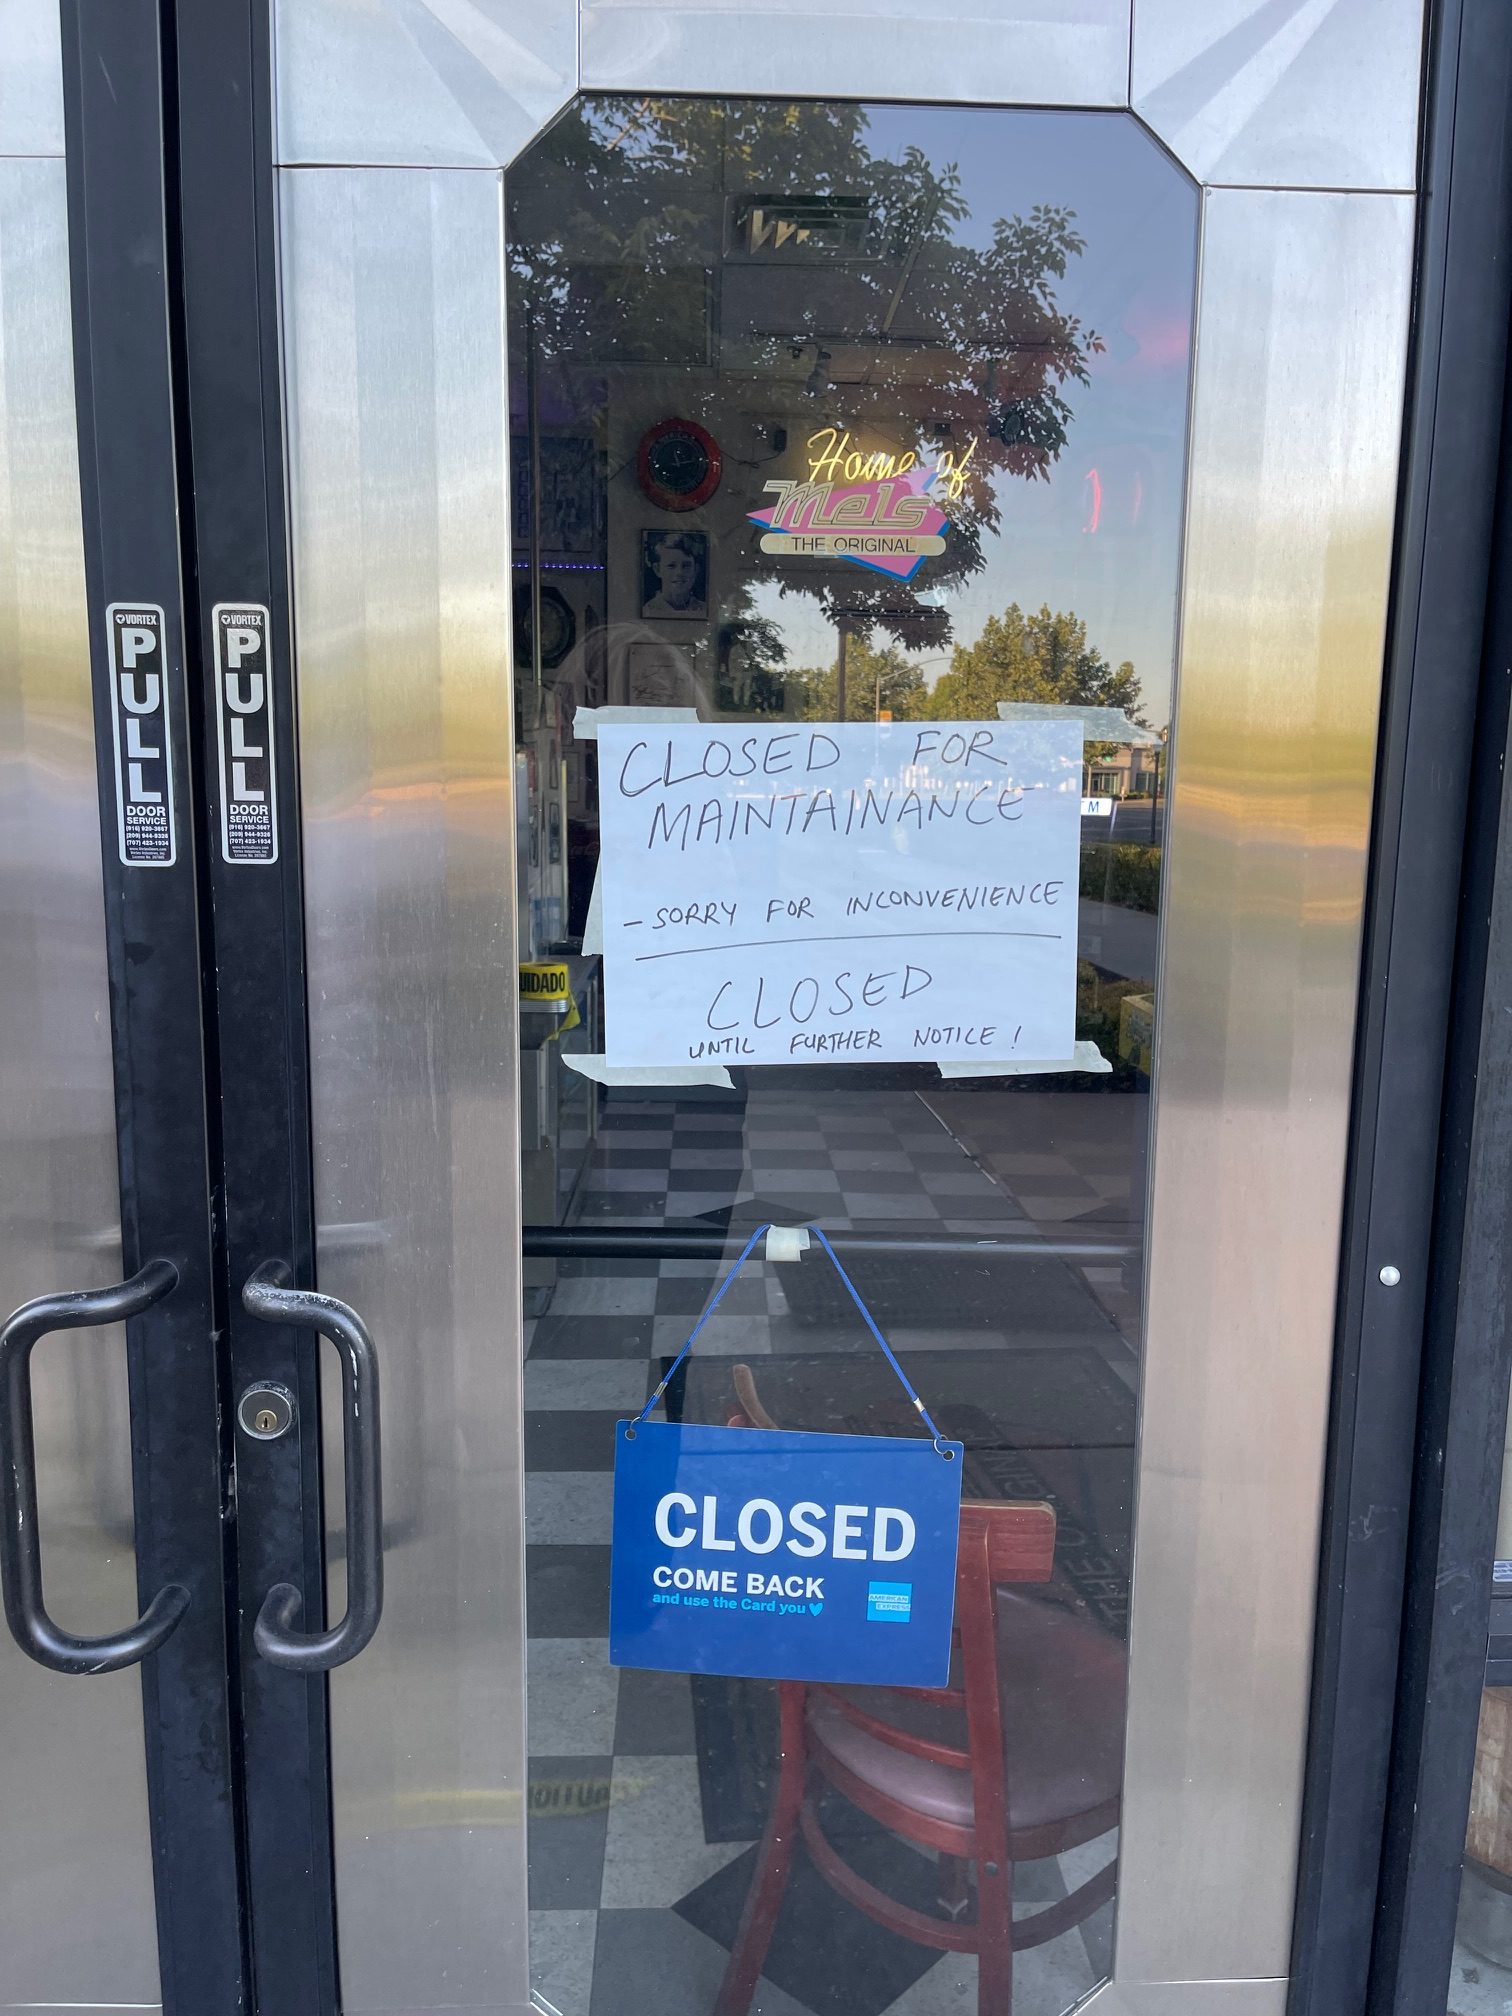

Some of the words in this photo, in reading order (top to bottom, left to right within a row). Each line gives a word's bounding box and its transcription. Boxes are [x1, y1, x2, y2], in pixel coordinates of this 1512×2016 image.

[807, 427, 916, 482] Home
[936, 436, 978, 499] of
[792, 537, 825, 552] THE
[833, 537, 916, 553] ORIGINAL
[125, 614, 158, 625] VORTEX
[230, 614, 262, 626] VORTEX
[120, 627, 162, 803] PULL
[225, 627, 265, 802] PULL
[620, 733, 840, 797] CLOSED
[912, 730, 1008, 766] FOR
[126, 805, 166, 817] DOOR
[126, 816, 167, 825] SERVICE
[229, 804, 269, 815] DOOR
[229, 815, 270, 824] SERVICE
[648, 786, 1035, 851] MAINTAINANCE
[126, 839, 142, 847] (707)
[766, 896, 815, 923] FOR
[846, 881, 1064, 916] INCONVENIENCE
[519, 971, 565, 994] UIDADO
[707, 964, 932, 1031] CLOSED
[689, 1036, 755, 1059] UNTIL
[790, 1028, 883, 1055] FURTHER
[654, 1492, 917, 1562] CLOSED
[653, 1565, 738, 1593] COME
[746, 1573, 825, 1600] BACK
[652, 1592, 680, 1605] and
[683, 1596, 710, 1607] use
[712, 1597, 738, 1610] the
[740, 1599, 776, 1613] Card
[778, 1603, 807, 1617] you
[869, 1594, 909, 1602] AMERICAN
